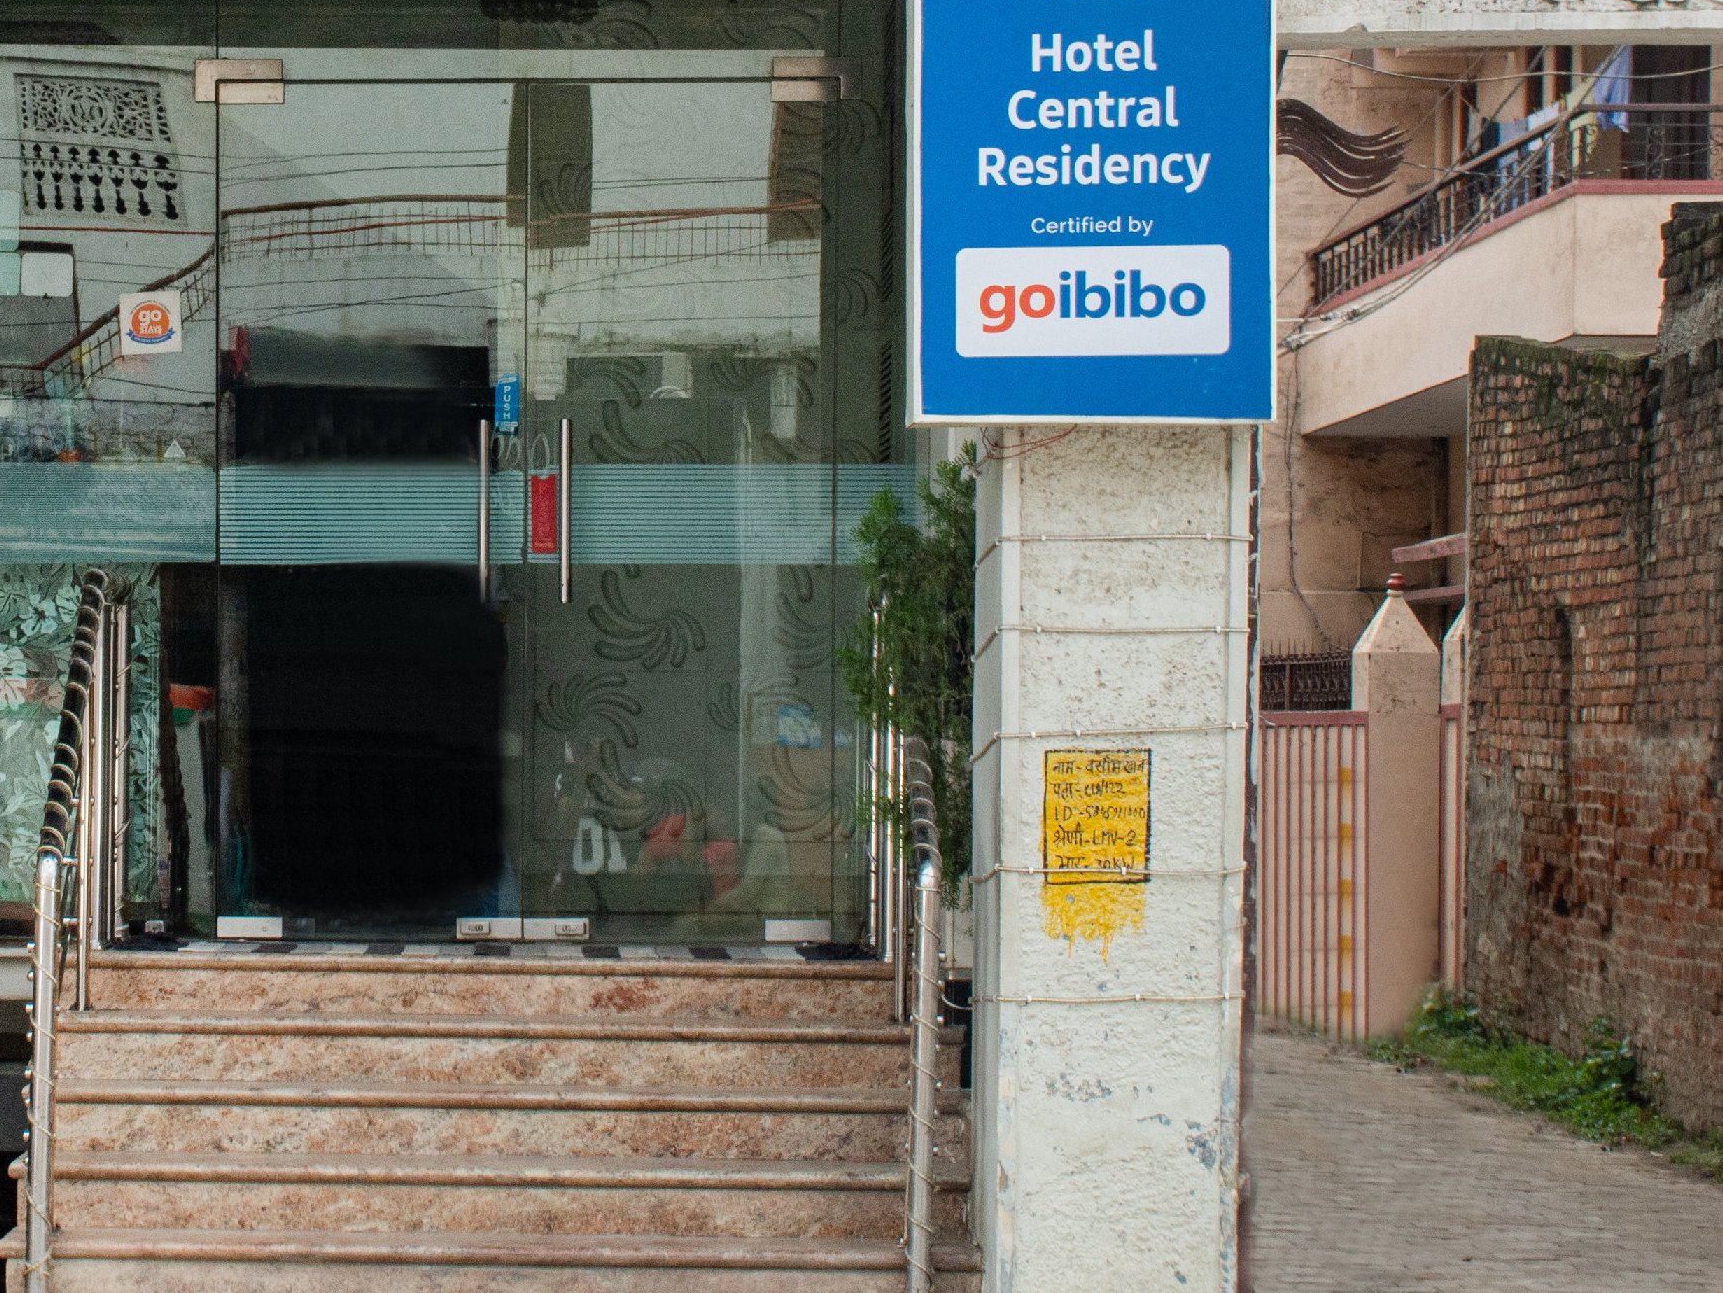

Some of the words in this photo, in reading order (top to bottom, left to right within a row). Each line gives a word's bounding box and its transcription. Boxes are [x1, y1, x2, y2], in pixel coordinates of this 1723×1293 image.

[1030, 28, 1157, 74] Hotel
[1006, 85, 1180, 130] Central
[977, 144, 1211, 193] Residency
[1030, 214, 1123, 236] Certified
[1127, 215, 1154, 238] by
[138, 310, 162, 326] go
[978, 269, 1207, 333] goibibo
[502, 385, 512, 420] PUSH
